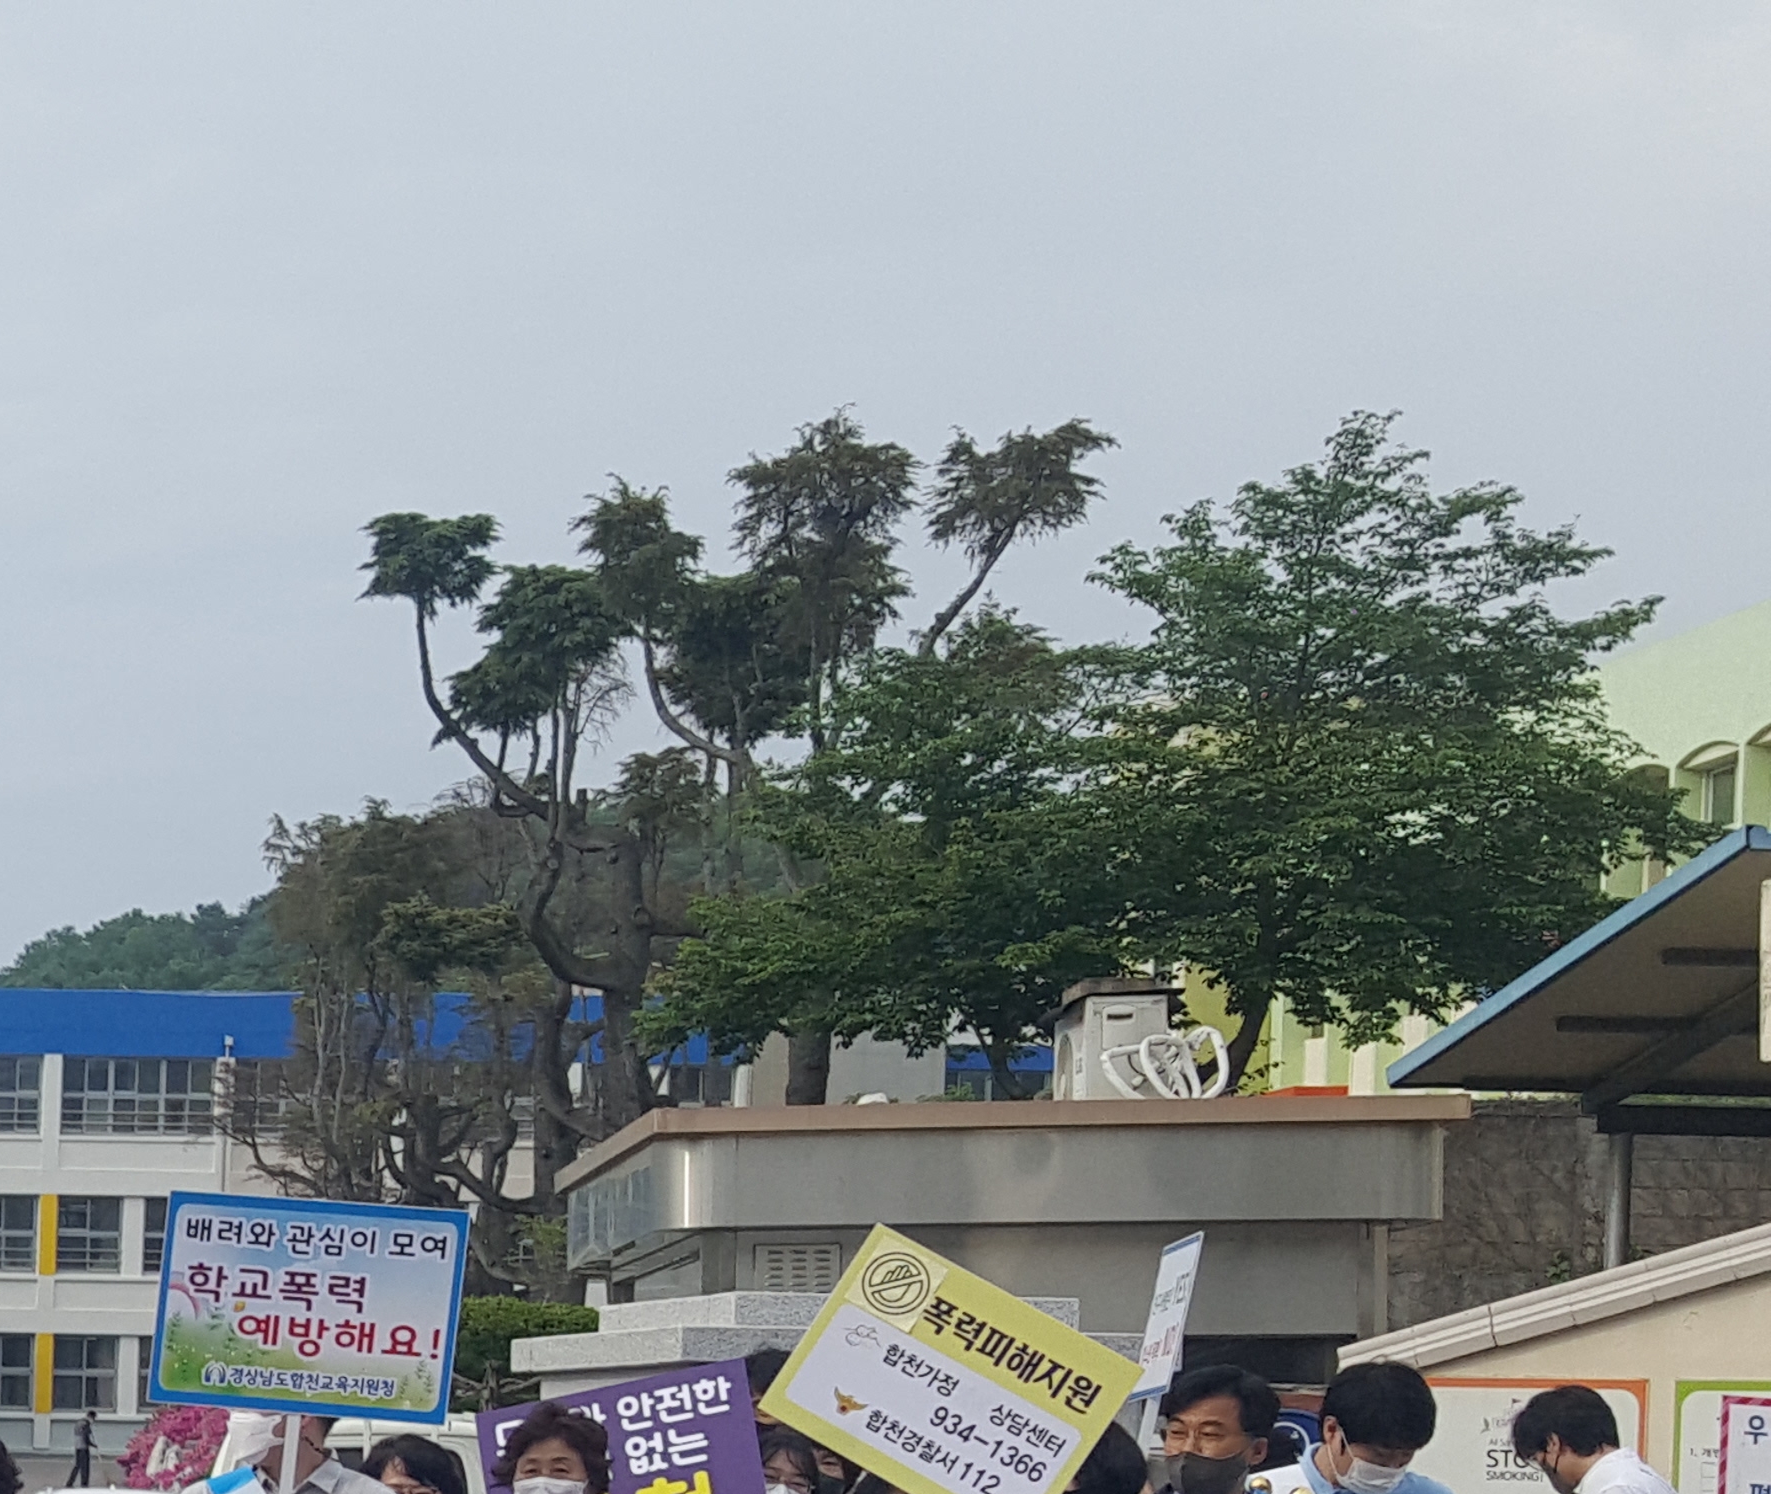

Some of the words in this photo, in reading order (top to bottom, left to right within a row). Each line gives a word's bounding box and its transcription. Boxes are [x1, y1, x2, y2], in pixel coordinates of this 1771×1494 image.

[185, 1217, 277, 1248] 배려와
[286, 1225, 377, 1257] 관심이
[388, 1233, 448, 1260] 모여
[187, 1263, 368, 1314] 학교폭력
[237, 1315, 442, 1360] 예방해요!
[922, 1295, 1104, 1416] 폭력피해지원
[229, 1367, 396, 1397] 경상남도합천교육지원청
[882, 1342, 961, 1398] 합천가정
[616, 1376, 733, 1432] 안전한
[1743, 1414, 1769, 1445] 우
[624, 1428, 710, 1476] 없는
[864, 1409, 959, 1475] 합천경찰서
[929, 1405, 1048, 1484] 934-1366
[987, 1403, 1068, 1459] 상담센터
[1486, 1449, 1531, 1469] STO
